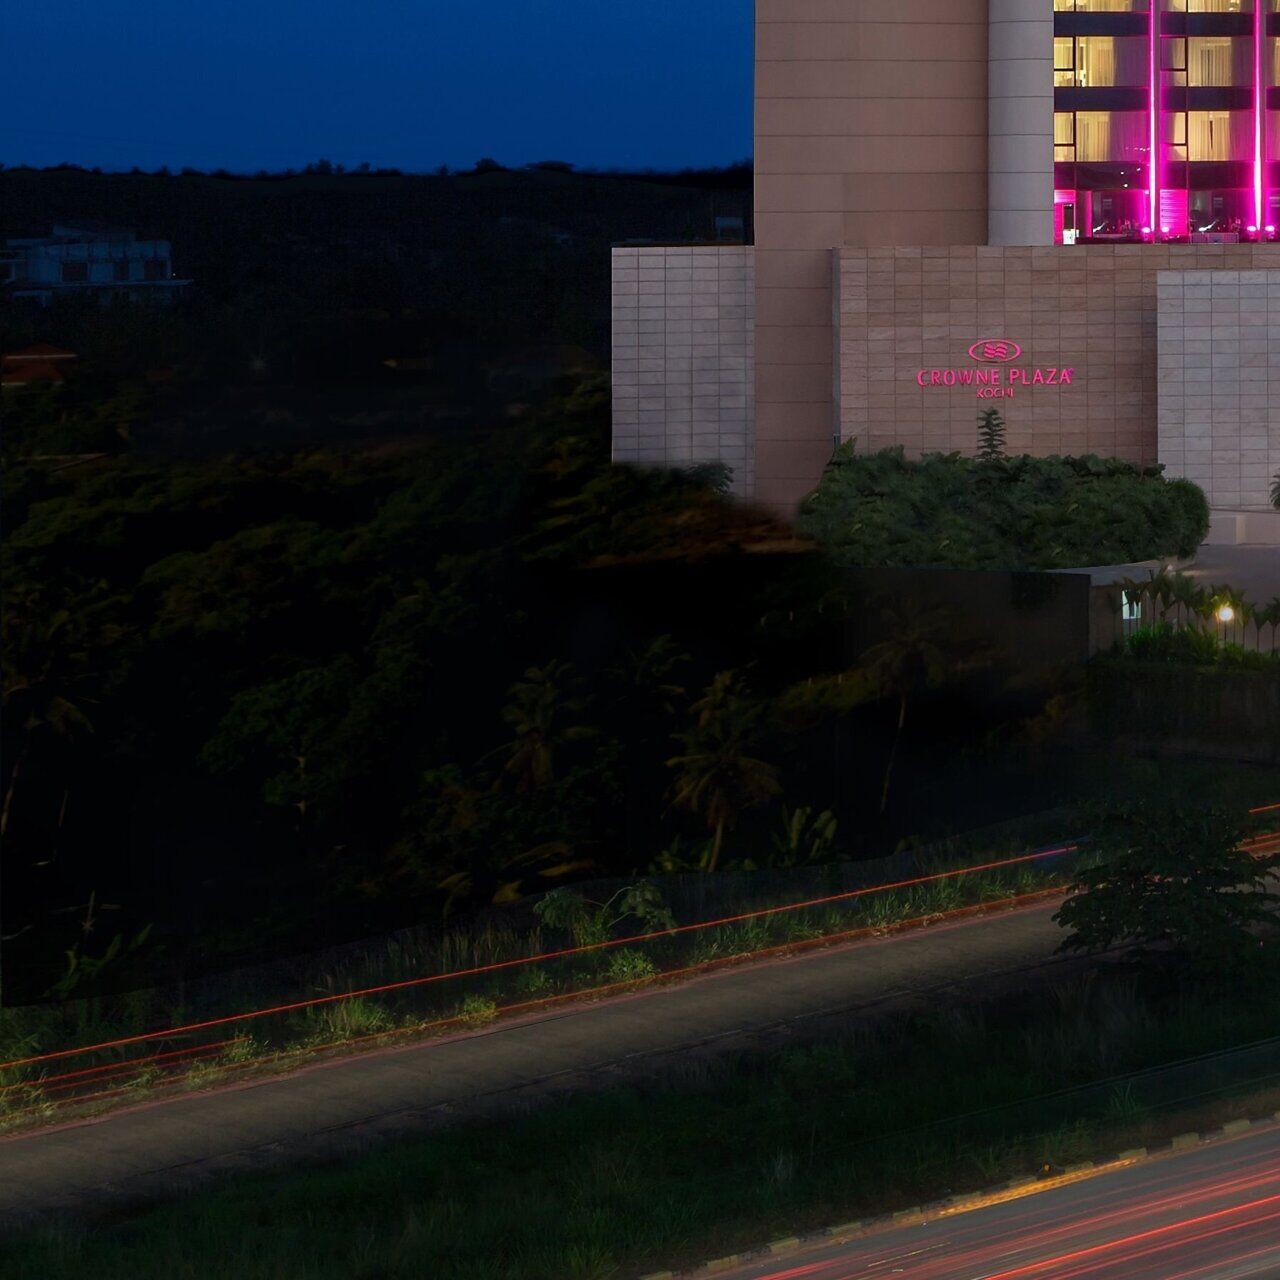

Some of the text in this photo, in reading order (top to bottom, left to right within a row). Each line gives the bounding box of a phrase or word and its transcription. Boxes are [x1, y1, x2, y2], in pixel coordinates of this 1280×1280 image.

[917, 368, 1071, 385] CROWNE PLAZA
[976, 388, 1014, 399] KOCHI
